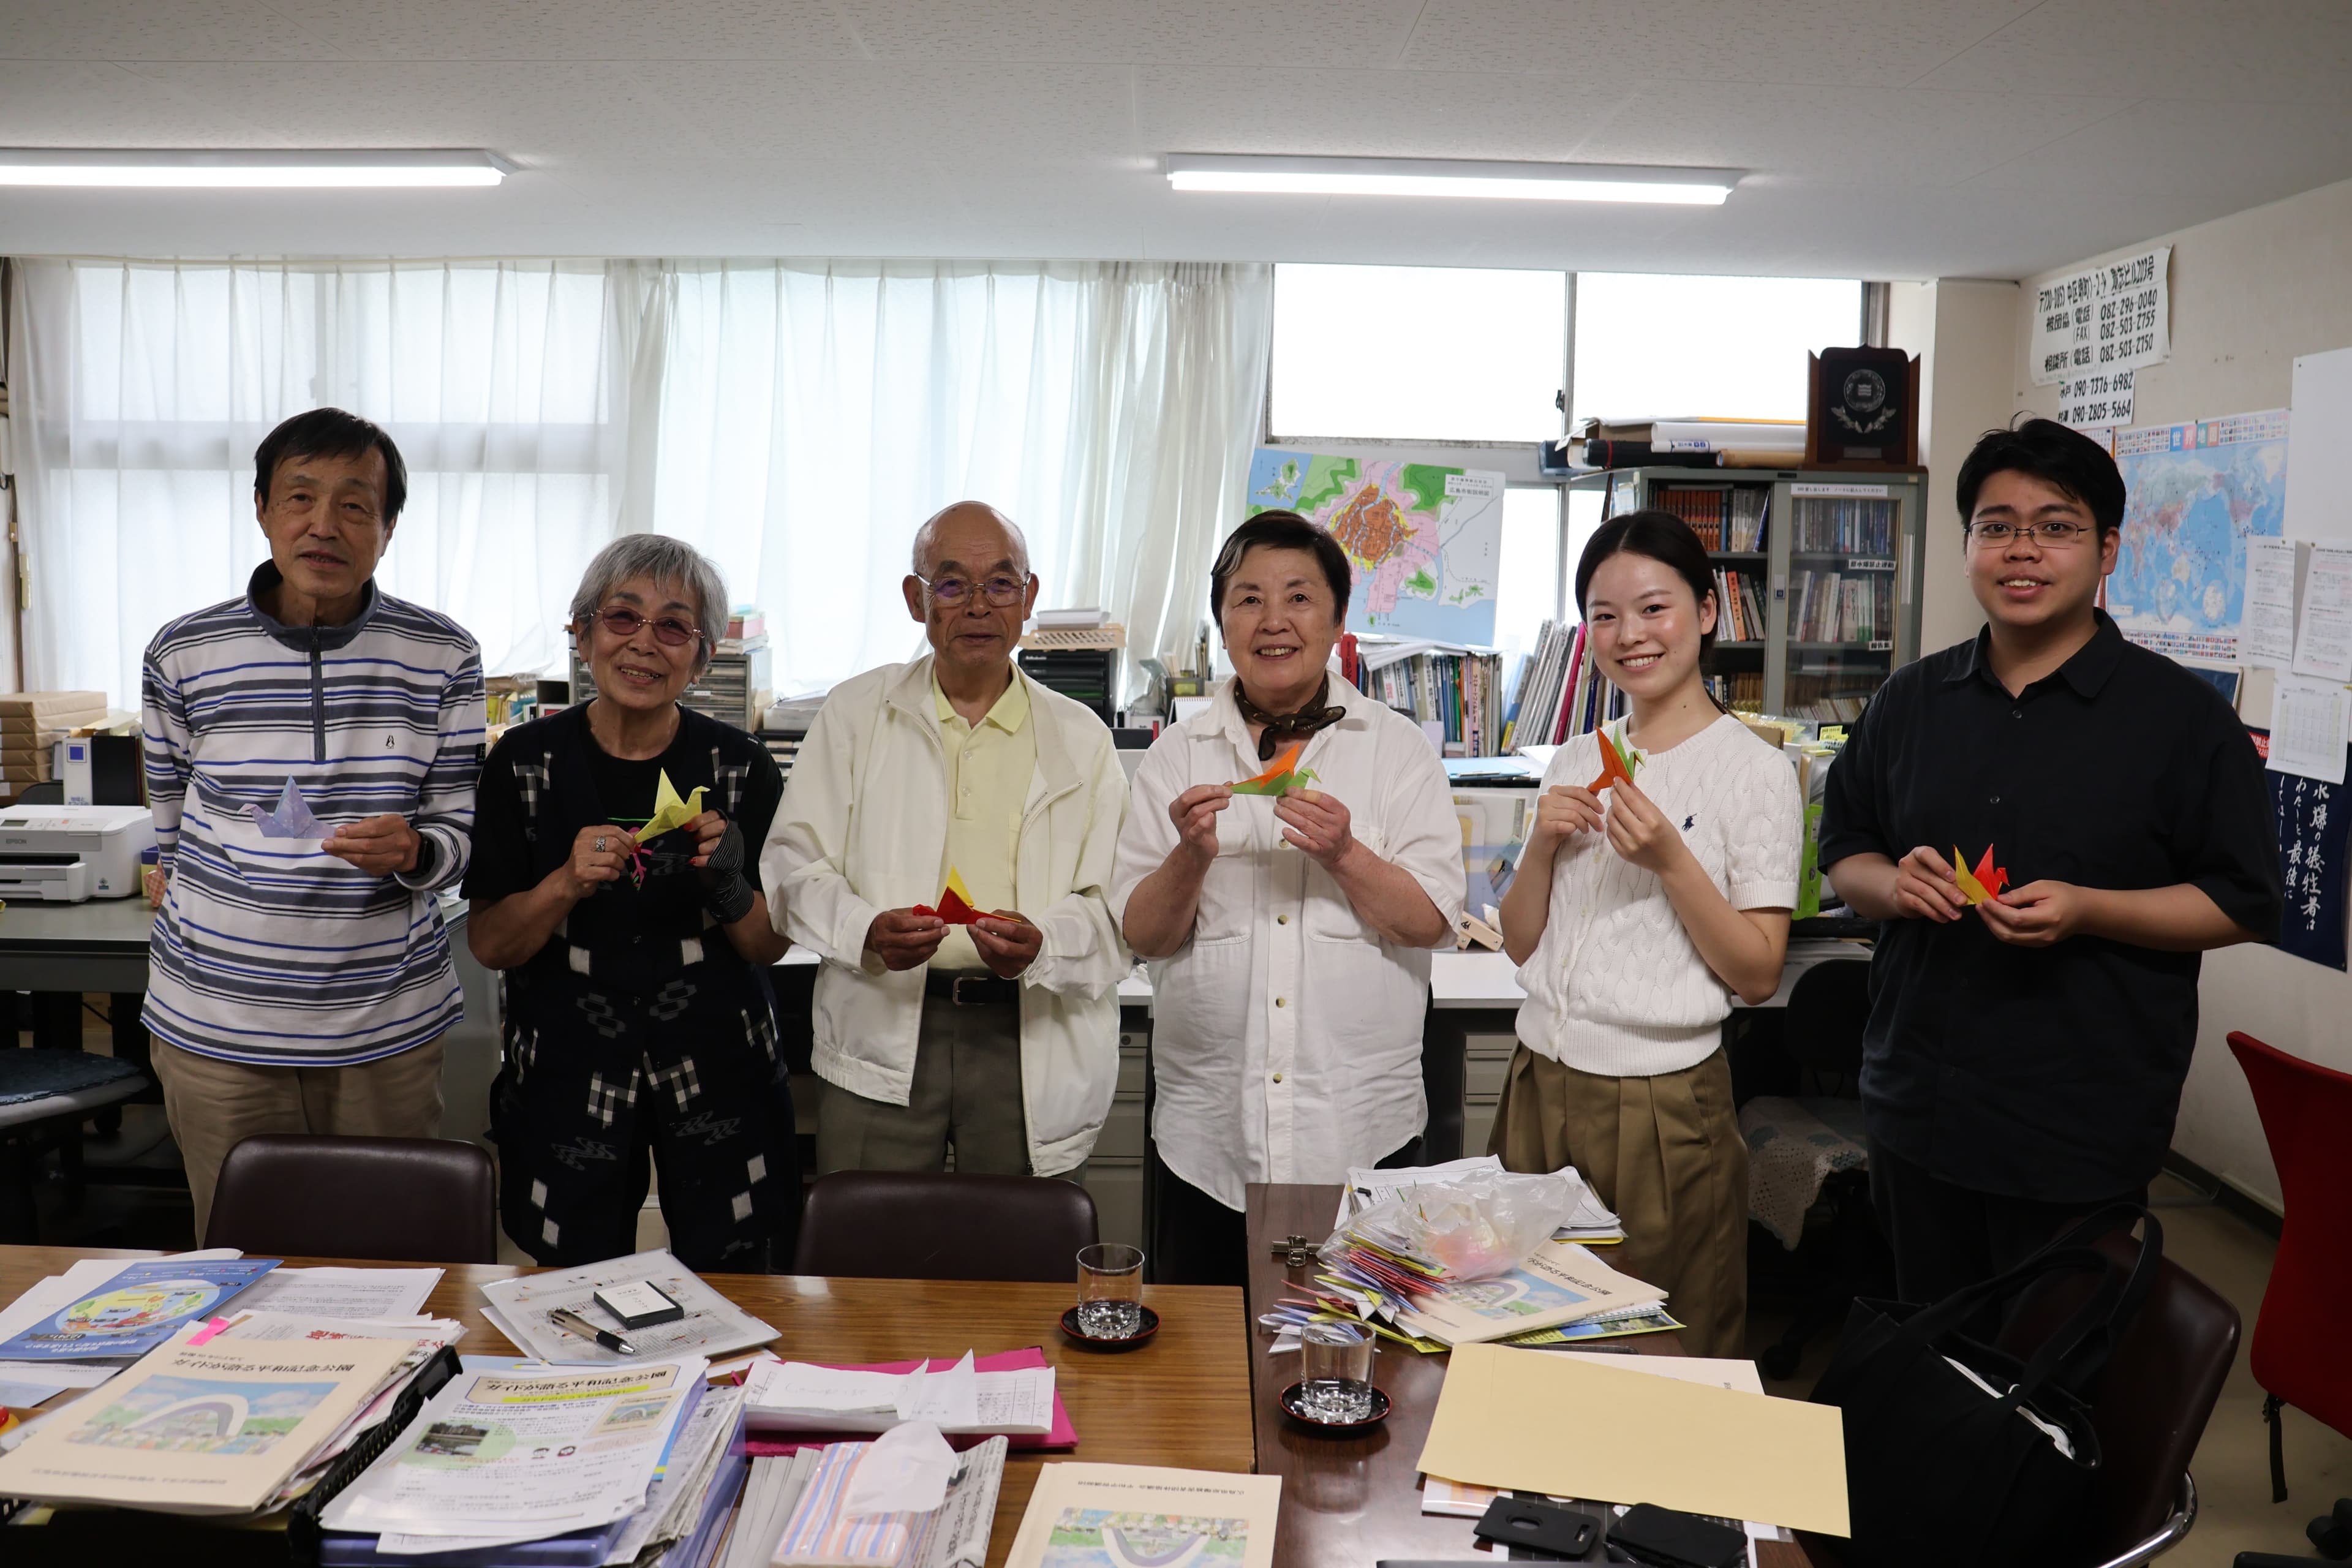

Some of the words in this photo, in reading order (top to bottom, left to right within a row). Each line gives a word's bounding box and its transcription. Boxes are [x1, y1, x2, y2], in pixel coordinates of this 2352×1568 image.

[2100, 289, 2157, 320] 082-296-0040
[2100, 309, 2155, 340] 082-503-2755
[2100, 333, 2154, 363] 082-503-2750
[2074, 371, 2134, 398] 090-7376-6982
[2073, 399, 2132, 423] 090-2805-5664
[2301, 780, 2330, 930] 水爆の犠牲者は
